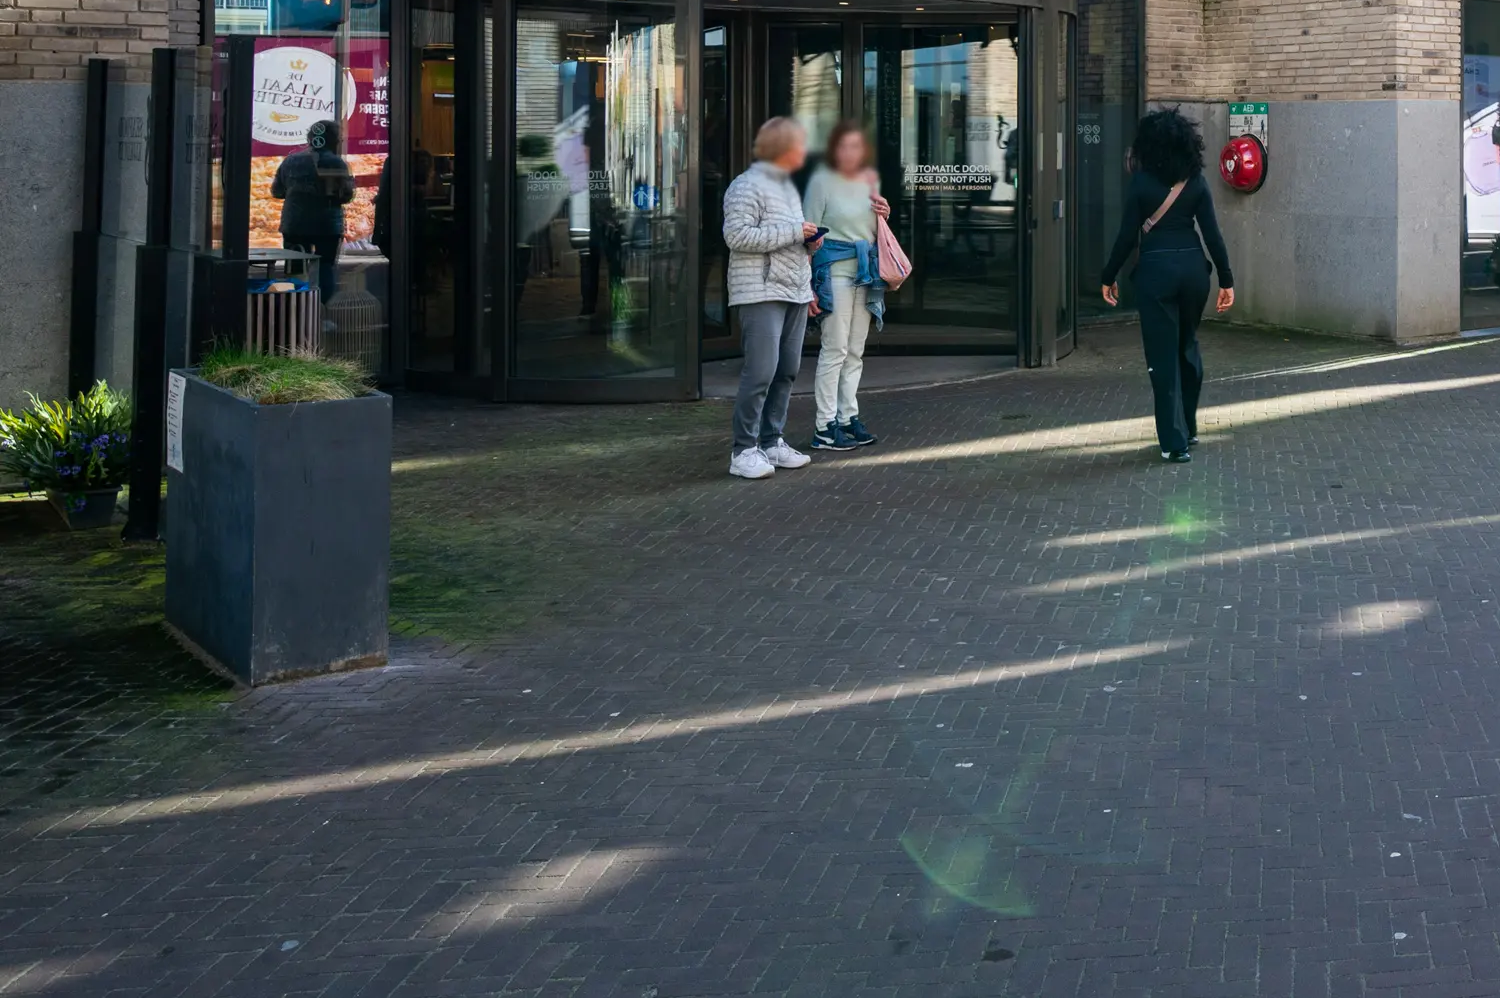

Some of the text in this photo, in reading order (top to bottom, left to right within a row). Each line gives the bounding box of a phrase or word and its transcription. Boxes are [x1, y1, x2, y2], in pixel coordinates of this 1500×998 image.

[1242, 104, 1255, 113] AED
[904, 165, 991, 173] AUTOMATIC DOOR
[904, 176, 992, 184] PLEASE DO NOT PUSH
